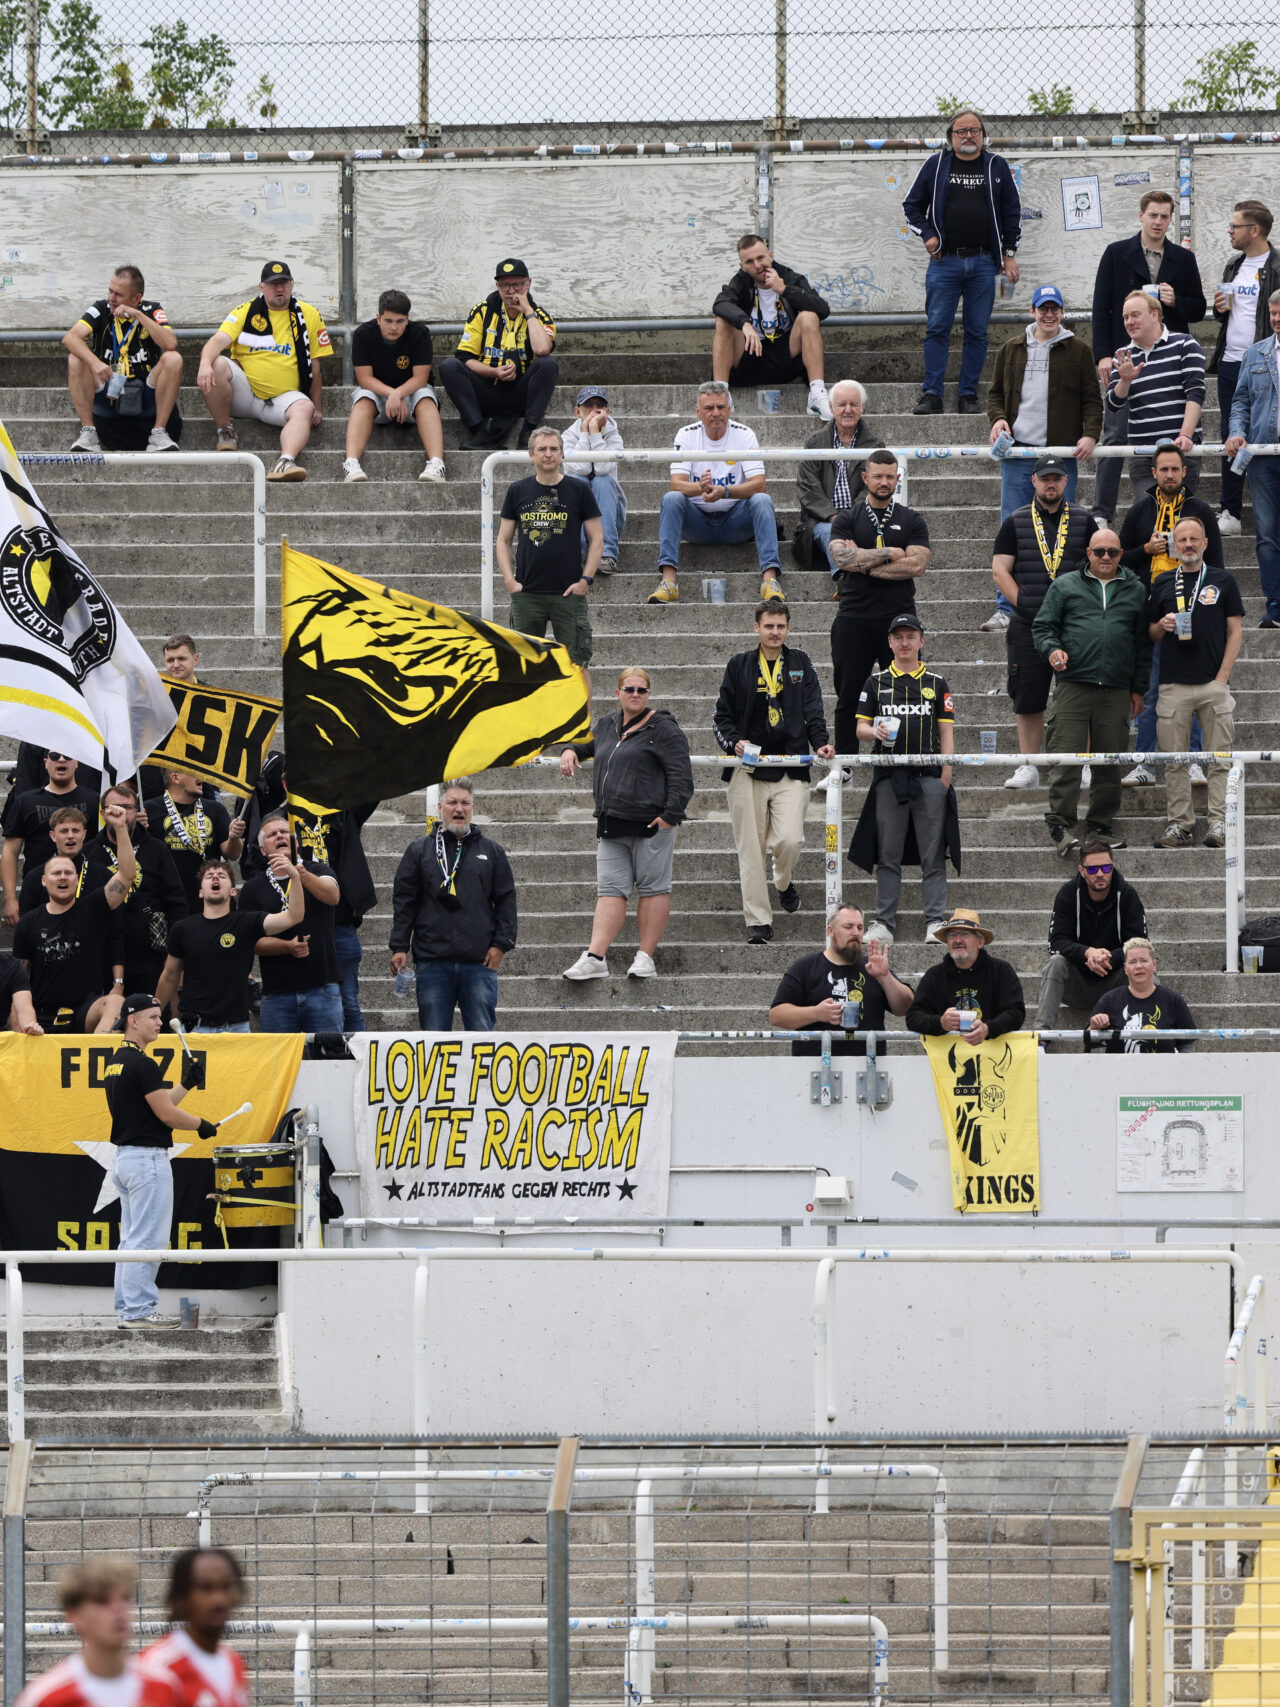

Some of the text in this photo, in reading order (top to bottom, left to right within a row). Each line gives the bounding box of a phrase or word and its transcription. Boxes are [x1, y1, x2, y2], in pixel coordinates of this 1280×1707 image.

[520, 512, 568, 521] NOSTROMO
[3, 566, 58, 639] ALTSTADT
[881, 701, 932, 716] maxit
[61, 1047, 207, 1091] FOZA
[368, 1039, 650, 1108] LOVE FOOTBALL
[1177, 1100, 1234, 1108] RETTUNGSPLAN
[375, 1105, 643, 1172] HATE RACISM
[407, 1180, 611, 1202] ALTSTADTFANS GEGEN RECHTS
